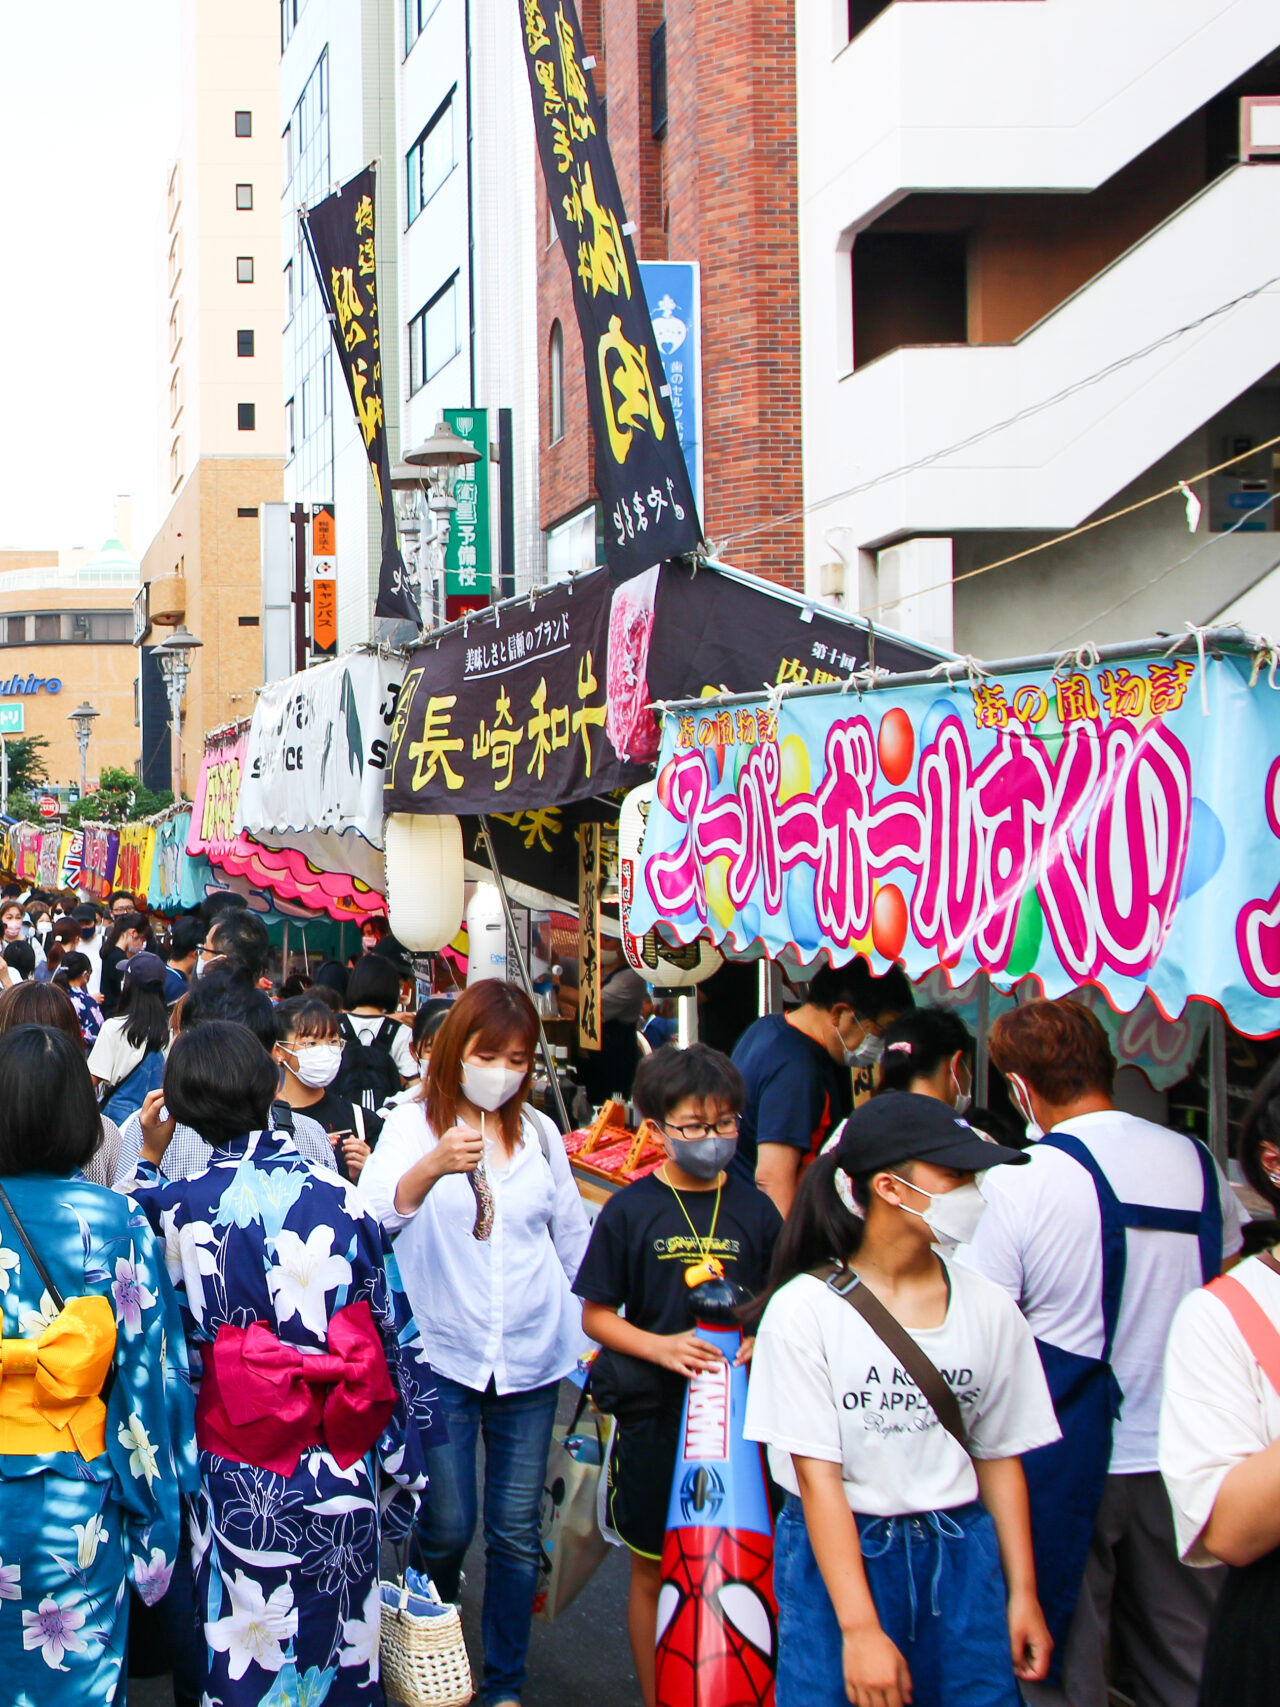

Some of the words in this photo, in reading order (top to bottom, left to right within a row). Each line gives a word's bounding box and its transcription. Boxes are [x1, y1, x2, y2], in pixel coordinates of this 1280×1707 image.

[316, 581, 333, 628] キャンバス
[464, 611, 570, 674] 美味しさと信頼のブランド
[970, 658, 1197, 731] 街の風物詩
[865, 1365, 881, 1384] A
[892, 1367, 974, 1386] ROND
[842, 1391, 872, 1411] OF
